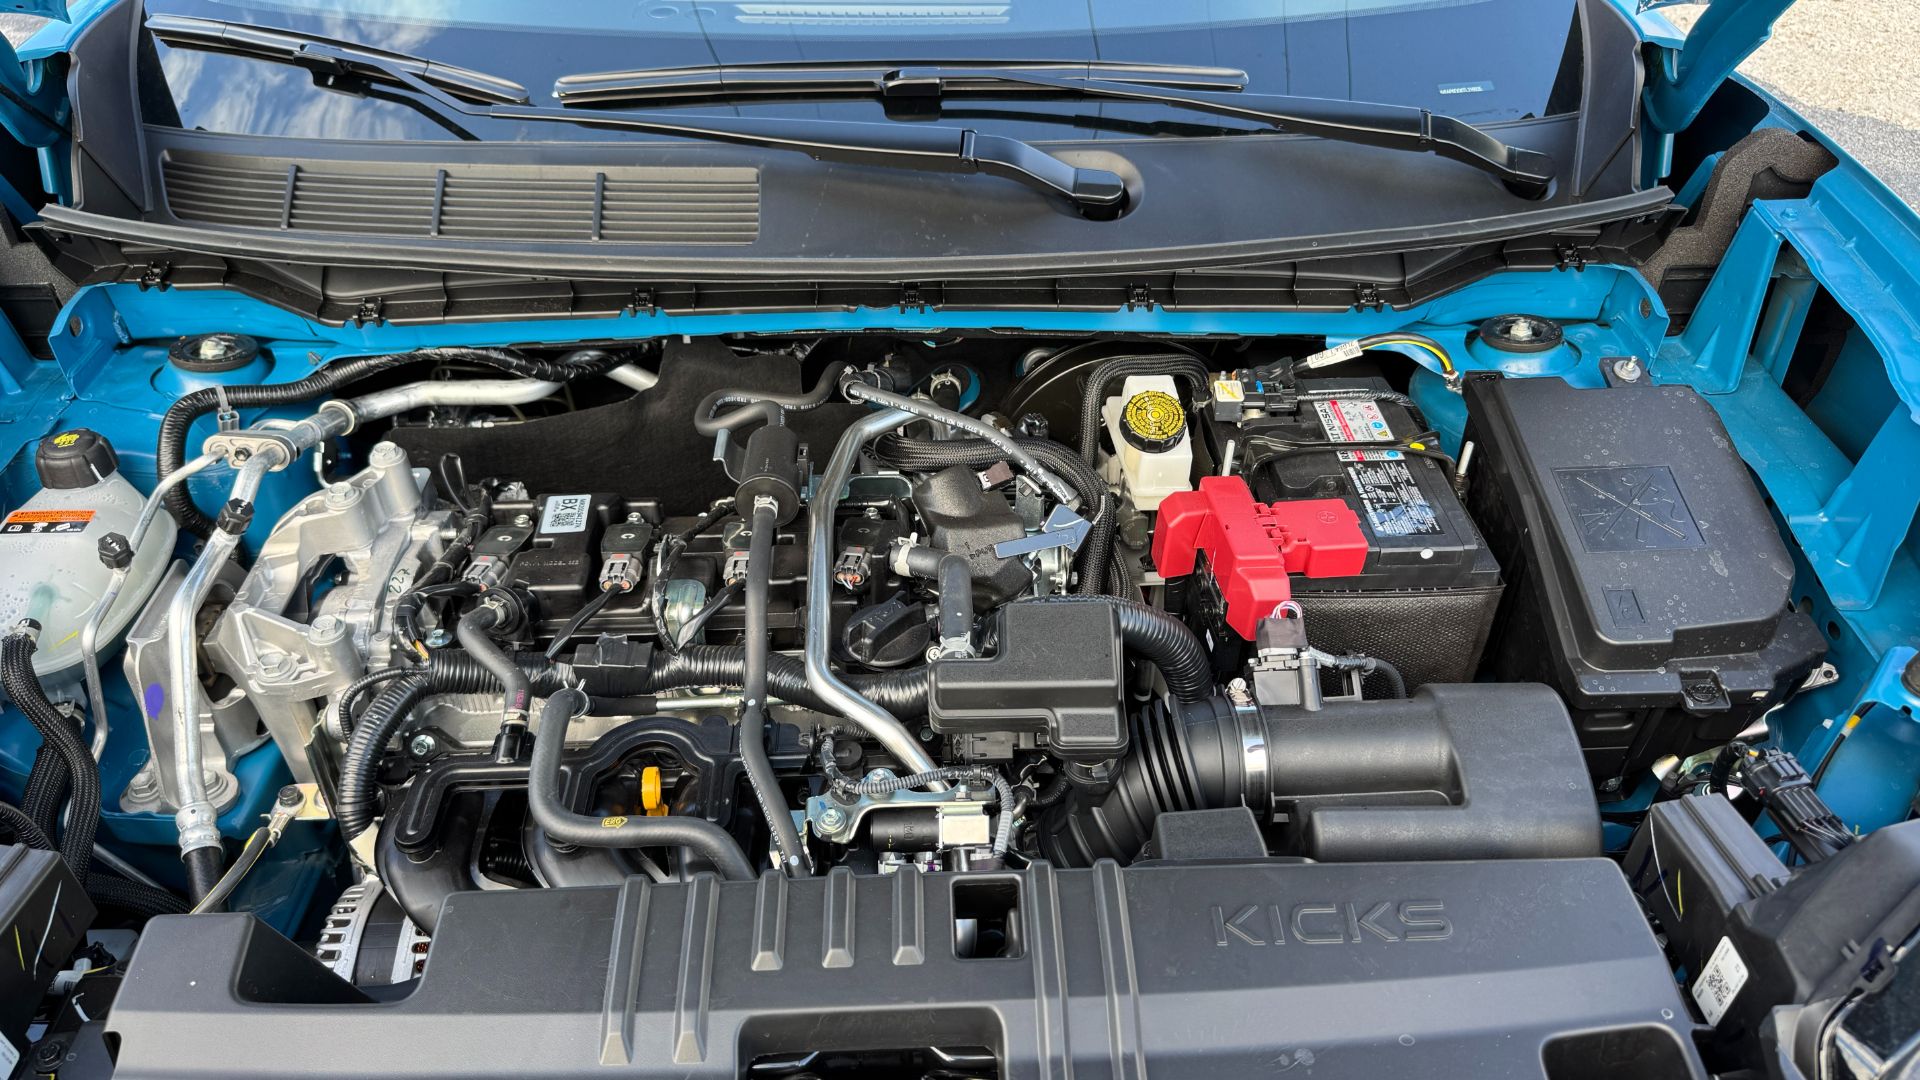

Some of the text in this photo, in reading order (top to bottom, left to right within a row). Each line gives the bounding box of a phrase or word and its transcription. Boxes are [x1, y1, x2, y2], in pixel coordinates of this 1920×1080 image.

[1316, 402, 1337, 431] NISSAN
[560, 498, 578, 511] BX
[1210, 899, 1454, 946] KICKS
